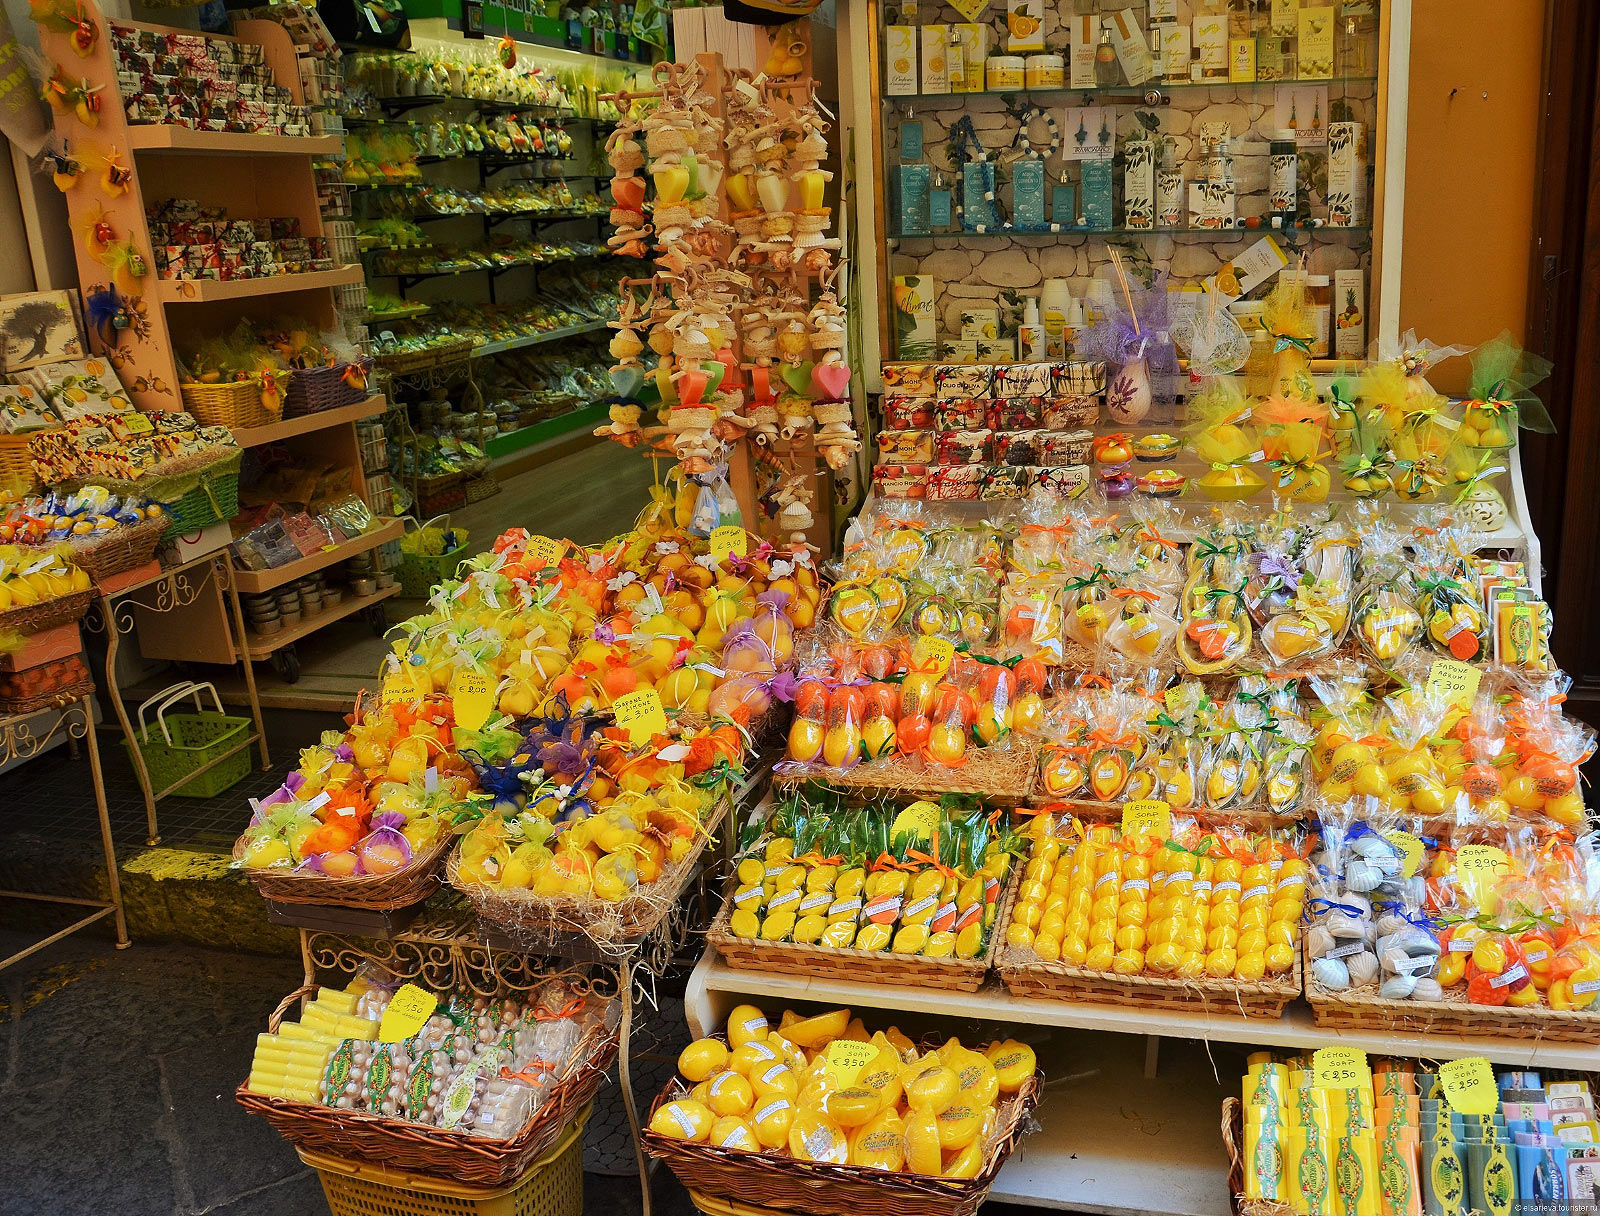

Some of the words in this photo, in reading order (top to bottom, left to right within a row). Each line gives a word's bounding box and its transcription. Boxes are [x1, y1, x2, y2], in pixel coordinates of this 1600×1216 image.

[534, 537, 556, 550] LEMON
[538, 545, 554, 555] SOAP
[1134, 811, 1159, 819] SOAP
[1460, 849, 1488, 857] SOAP
[1463, 860, 1473, 870] €
[1474, 858, 1498, 871] 2,90
[842, 1058, 866, 1070] 2,50
[1320, 1070, 1331, 1080] €
[1332, 1070, 1356, 1082] 2,50
[1454, 1069, 1477, 1079] SOAP
[1448, 1081, 1457, 1092] €
[1459, 1078, 1479, 1092] 2,50
[1310, 1164, 1318, 1188] SORRENTO
[1344, 1165, 1352, 1190] SORRENTO
[1390, 1169, 1398, 1193] SORRENTO
